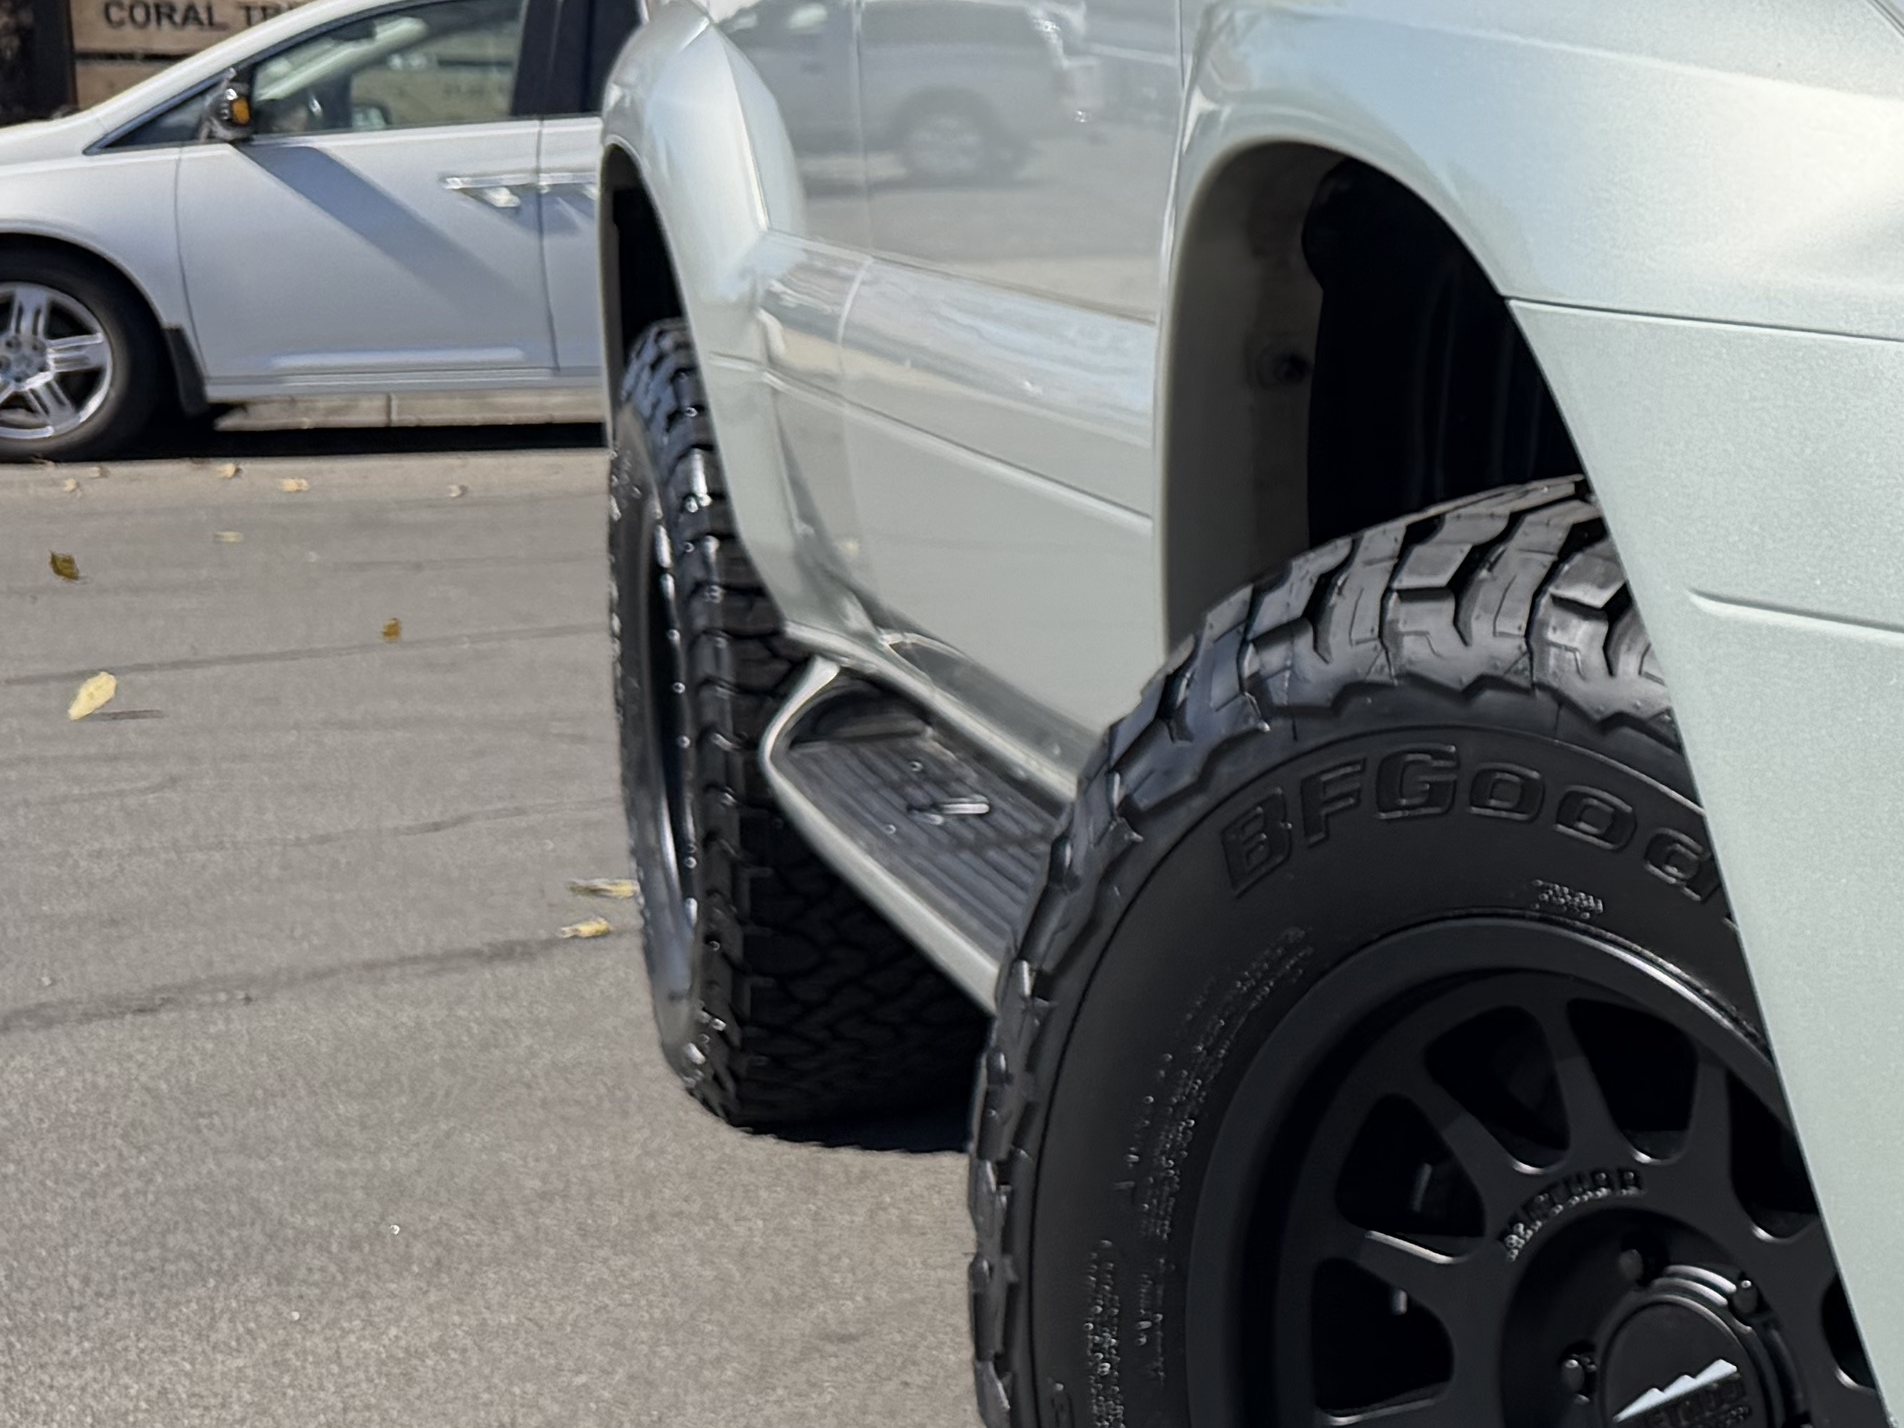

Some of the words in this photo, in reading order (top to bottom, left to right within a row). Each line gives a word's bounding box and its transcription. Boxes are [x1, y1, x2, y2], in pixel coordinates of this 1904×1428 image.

[104, 0, 229, 30] CORAL
[235, 0, 303, 29] TR
[1219, 744, 1727, 907] BFGood
